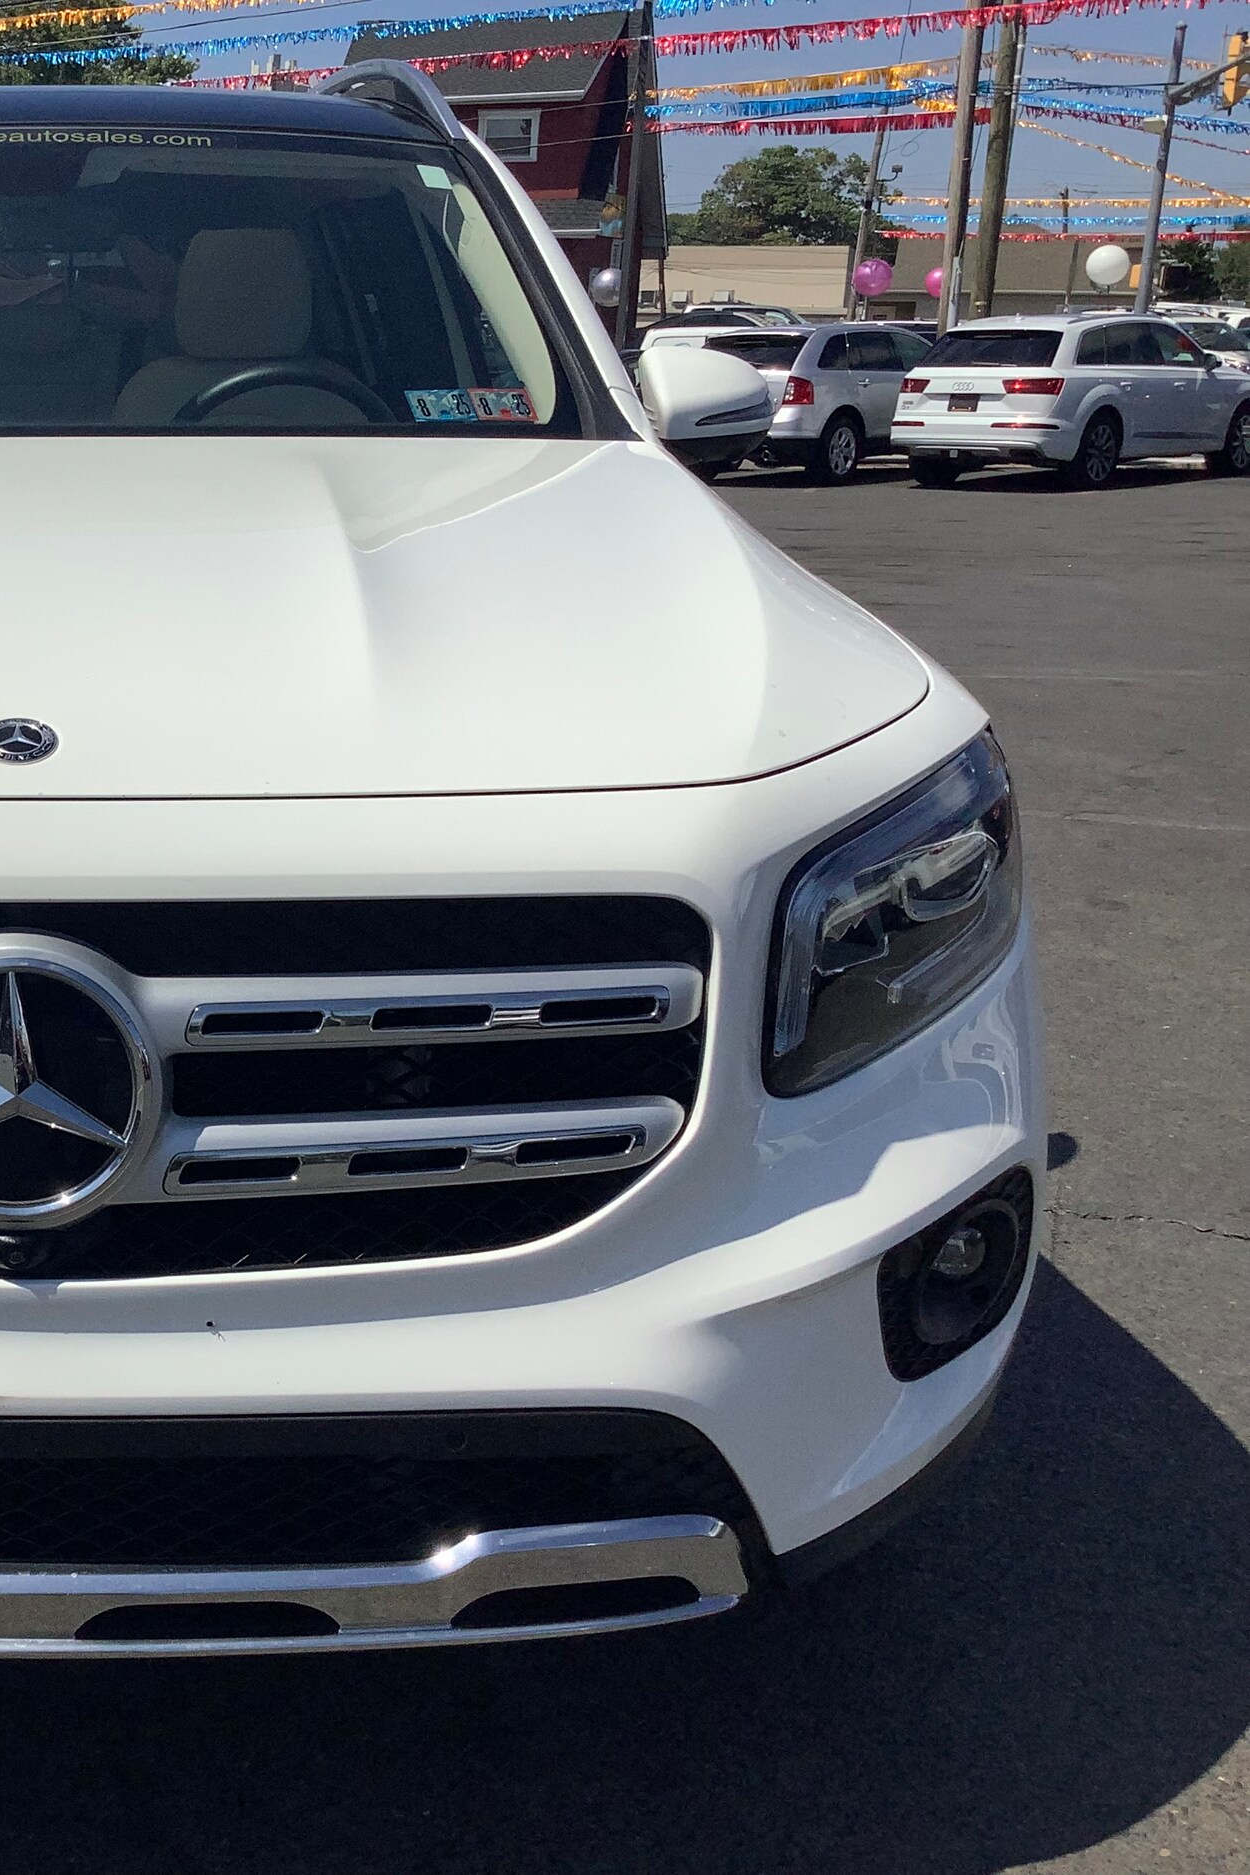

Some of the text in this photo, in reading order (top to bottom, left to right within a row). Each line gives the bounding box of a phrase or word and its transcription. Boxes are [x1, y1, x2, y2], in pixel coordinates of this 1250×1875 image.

[417, 393, 471, 417] 8 25
[479, 393, 531, 416] 8 25
